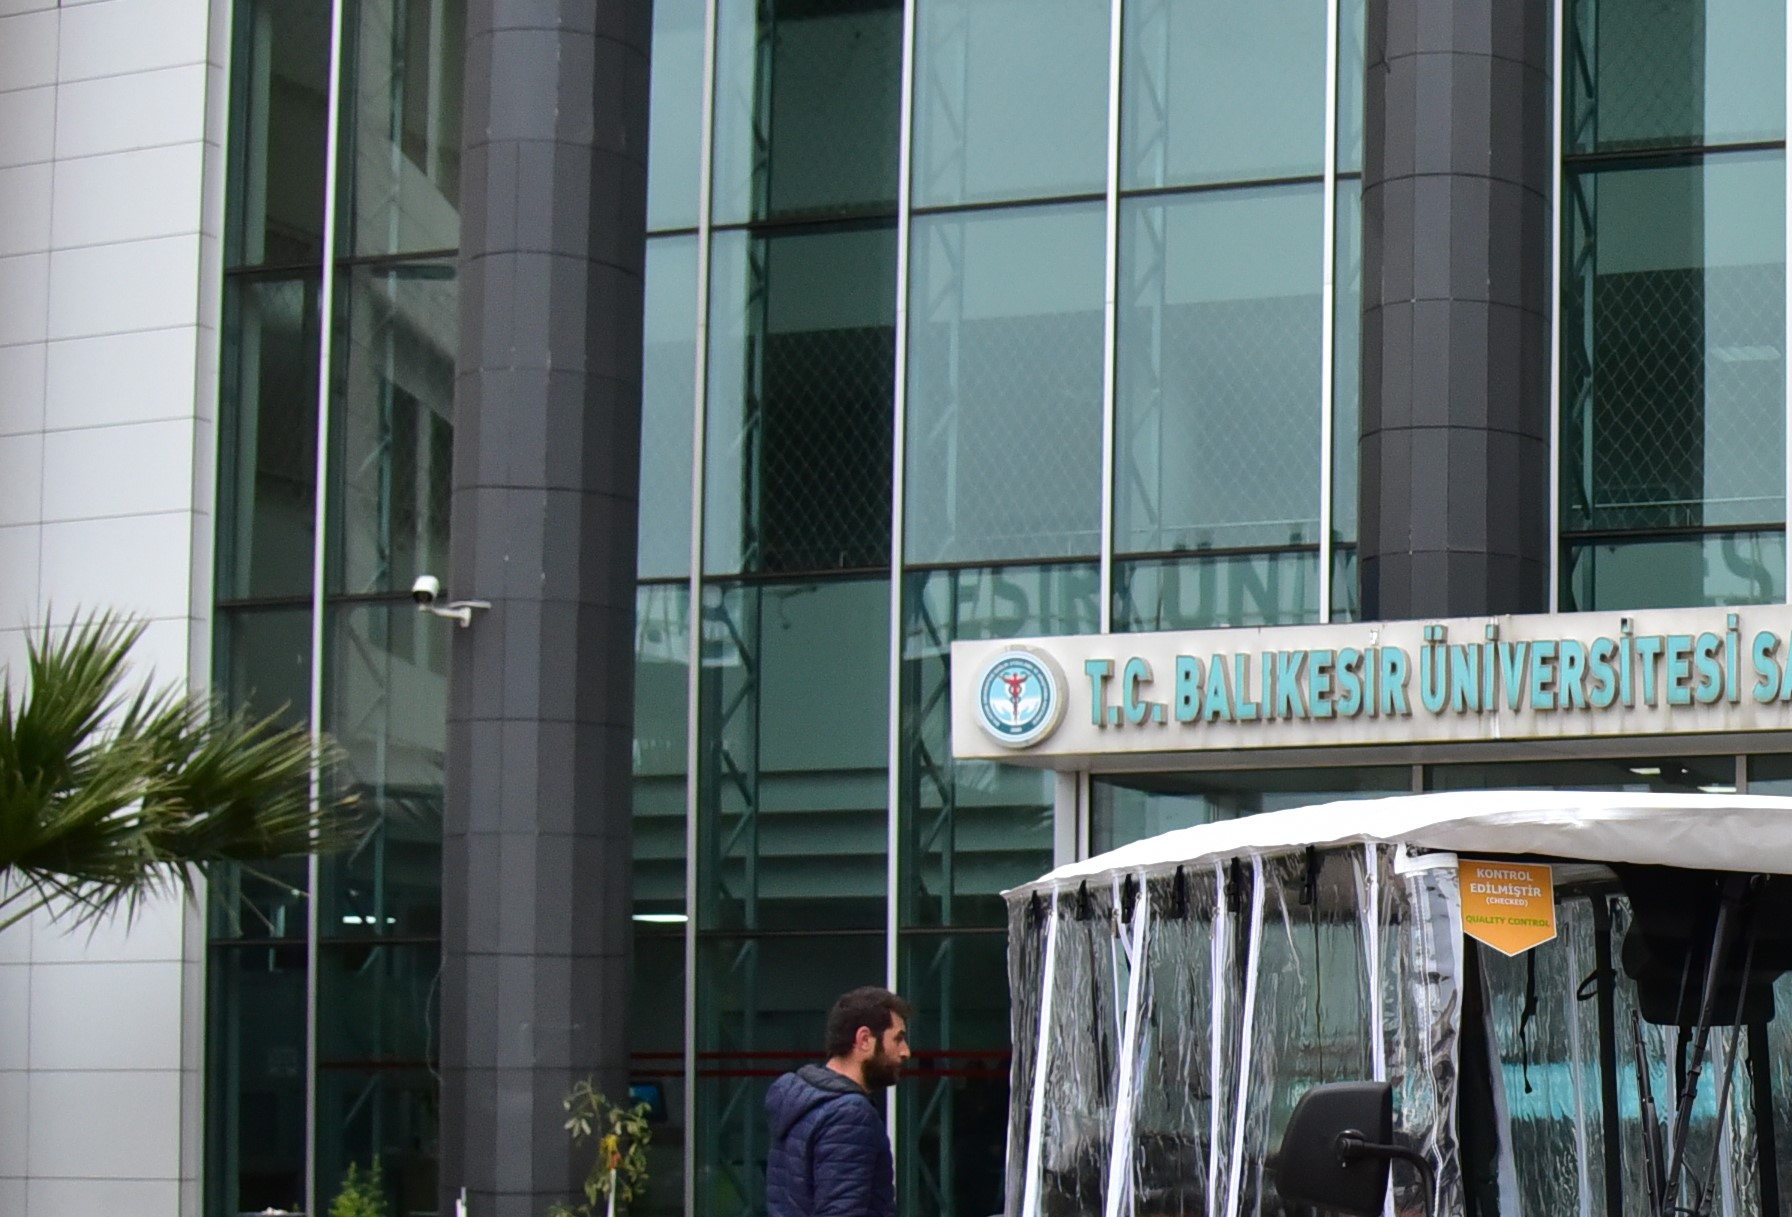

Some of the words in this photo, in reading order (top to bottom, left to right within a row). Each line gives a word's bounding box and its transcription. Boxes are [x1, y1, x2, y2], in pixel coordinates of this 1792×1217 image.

[1085, 656, 1168, 727] T.C.
[1175, 629, 1412, 724] BALIKESİR
[1420, 613, 1741, 715] ÜNİVERSİTESİ
[1477, 868, 1534, 882] KONTROL
[1470, 881, 1541, 897] EDİLMİŞTİR
[1486, 896, 1529, 908] (CHECKED)
[1466, 914, 1506, 925] QUALITY
[1507, 916, 1550, 928] CONTROL
